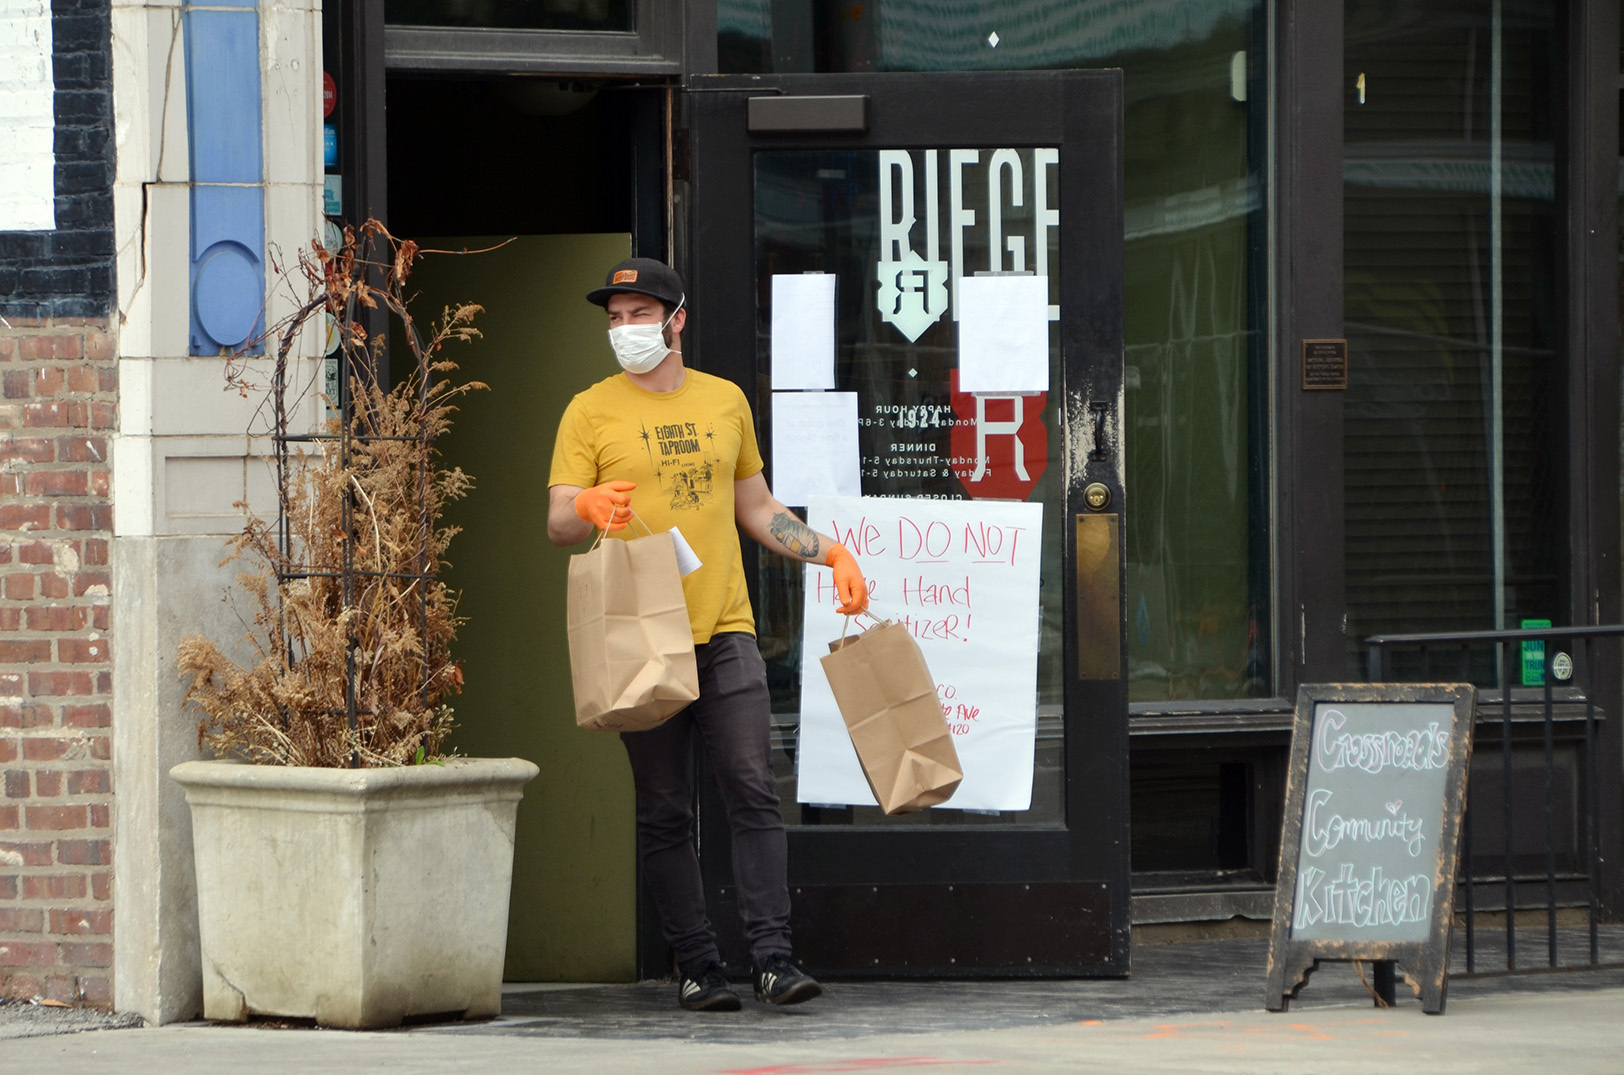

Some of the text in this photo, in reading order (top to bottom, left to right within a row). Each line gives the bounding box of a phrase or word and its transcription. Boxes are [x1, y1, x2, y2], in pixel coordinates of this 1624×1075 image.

[899, 409, 940, 428] 1924
[654, 424, 685, 440] EIGHTH
[658, 439, 701, 456] TAPROOM
[661, 459, 680, 467] HI-FI
[899, 516, 952, 561] DO
[965, 521, 1027, 567] NOT
[817, 571, 971, 609] He Hand
[1294, 863, 1431, 929] Kitchen
